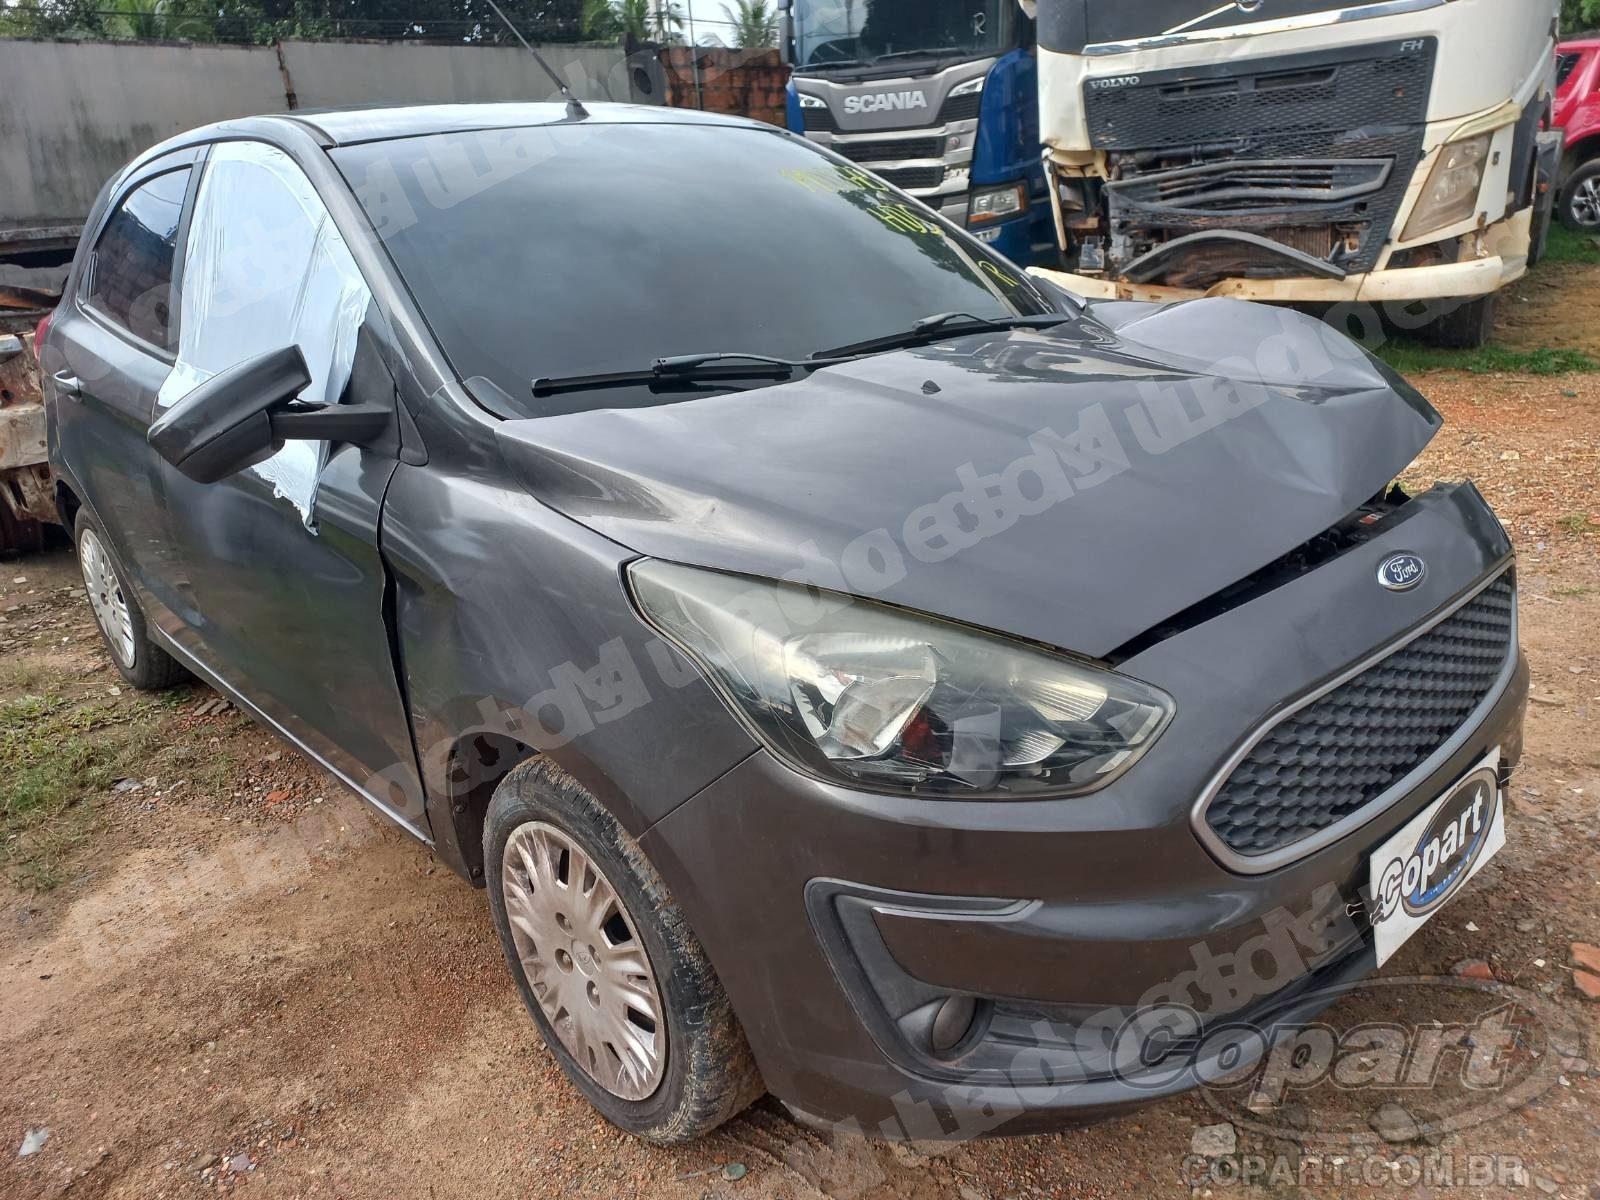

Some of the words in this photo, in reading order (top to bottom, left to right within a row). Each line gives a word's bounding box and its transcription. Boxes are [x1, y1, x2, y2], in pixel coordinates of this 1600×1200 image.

[1400, 39, 1425, 51] FH
[1088, 76, 1140, 89] VOLVO
[844, 90, 928, 114] SCANIA
[1390, 558, 1419, 583] Ford
[1379, 785, 1483, 920] Copart
